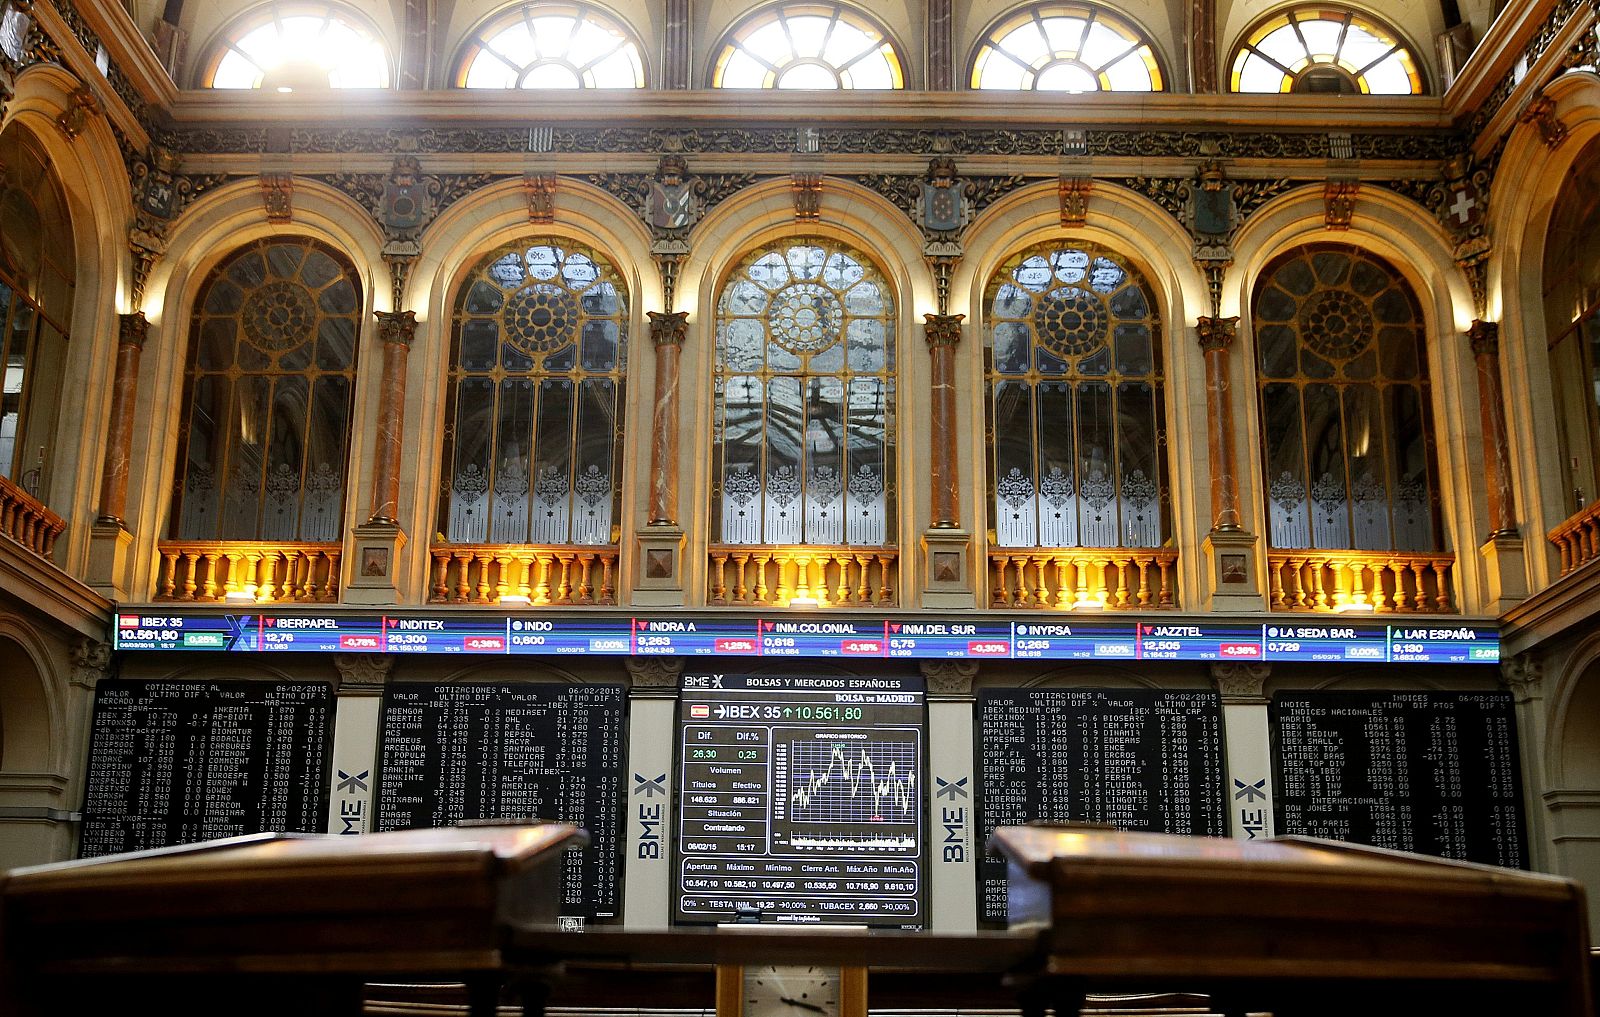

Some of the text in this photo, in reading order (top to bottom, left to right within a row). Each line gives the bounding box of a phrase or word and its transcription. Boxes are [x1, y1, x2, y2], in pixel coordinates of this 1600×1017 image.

[142, 618, 182, 626] IBEX 35
[276, 619, 338, 628] IBERPAPEL
[400, 620, 444, 630] INDITEX
[524, 622, 552, 631] INDO
[650, 622, 696, 632] INDRA A
[776, 623, 856, 634] INM.COLONIAL
[902, 624, 976, 634] INM.DEL SUR
[1029, 626, 1072, 636] INYPSA
[1154, 626, 1202, 636] JAZZTEL
[1280, 628, 1356, 638] LA SEDA BAR.
[120, 630, 178, 641] 10.561,80
[265, 633, 294, 643] 12,76
[388, 634, 428, 644] 26,300
[1405, 628, 1476, 640] LAR ESPAÑA
[594, 640, 624, 649] 0,00%
[764, 638, 794, 648] 0,618
[890, 640, 1005, 654] 6,75 -0,30%
[1017, 640, 1129, 654] 0,265 0,00%
[1143, 642, 1180, 651] 12,505
[1350, 647, 1379, 656] 0,00%
[1393, 644, 1424, 654] 9,130
[685, 676, 710, 688] BME
[746, 678, 901, 688] BOLSAS Y MERCADOS ESPAÑOLES
[835, 694, 864, 702] BOLSA
[876, 694, 915, 703] MADRID
[726, 706, 862, 721] IBEX 35 10.561,80
[697, 731, 759, 741] Dif. Dif.%
[692, 750, 757, 760] 26,30 0,25
[710, 766, 742, 775] Volumen
[732, 781, 762, 790] Efectivo
[340, 800, 362, 834] ME
[708, 809, 742, 818] Situación
[638, 804, 660, 860] BME
[703, 824, 746, 832] Contratando
[943, 807, 964, 862] BME
[687, 842, 755, 852] 06/02/15 15:17
[686, 862, 914, 875] Apertura Máximo Mínimo Cierre Ant. Máx.Año Mín.Año
[685, 879, 914, 892] 10.547,10 10.582,10 10.497,50 10.535,50 10.716,90 9.610,10
[709, 901, 734, 909] TESTA
[756, 901, 775, 910] 19,25
[784, 902, 807, 910] 0,00%
[819, 903, 855, 911] TUBACEX
[858, 903, 878, 911] 2,660
[888, 903, 910, 911] 0,00%
